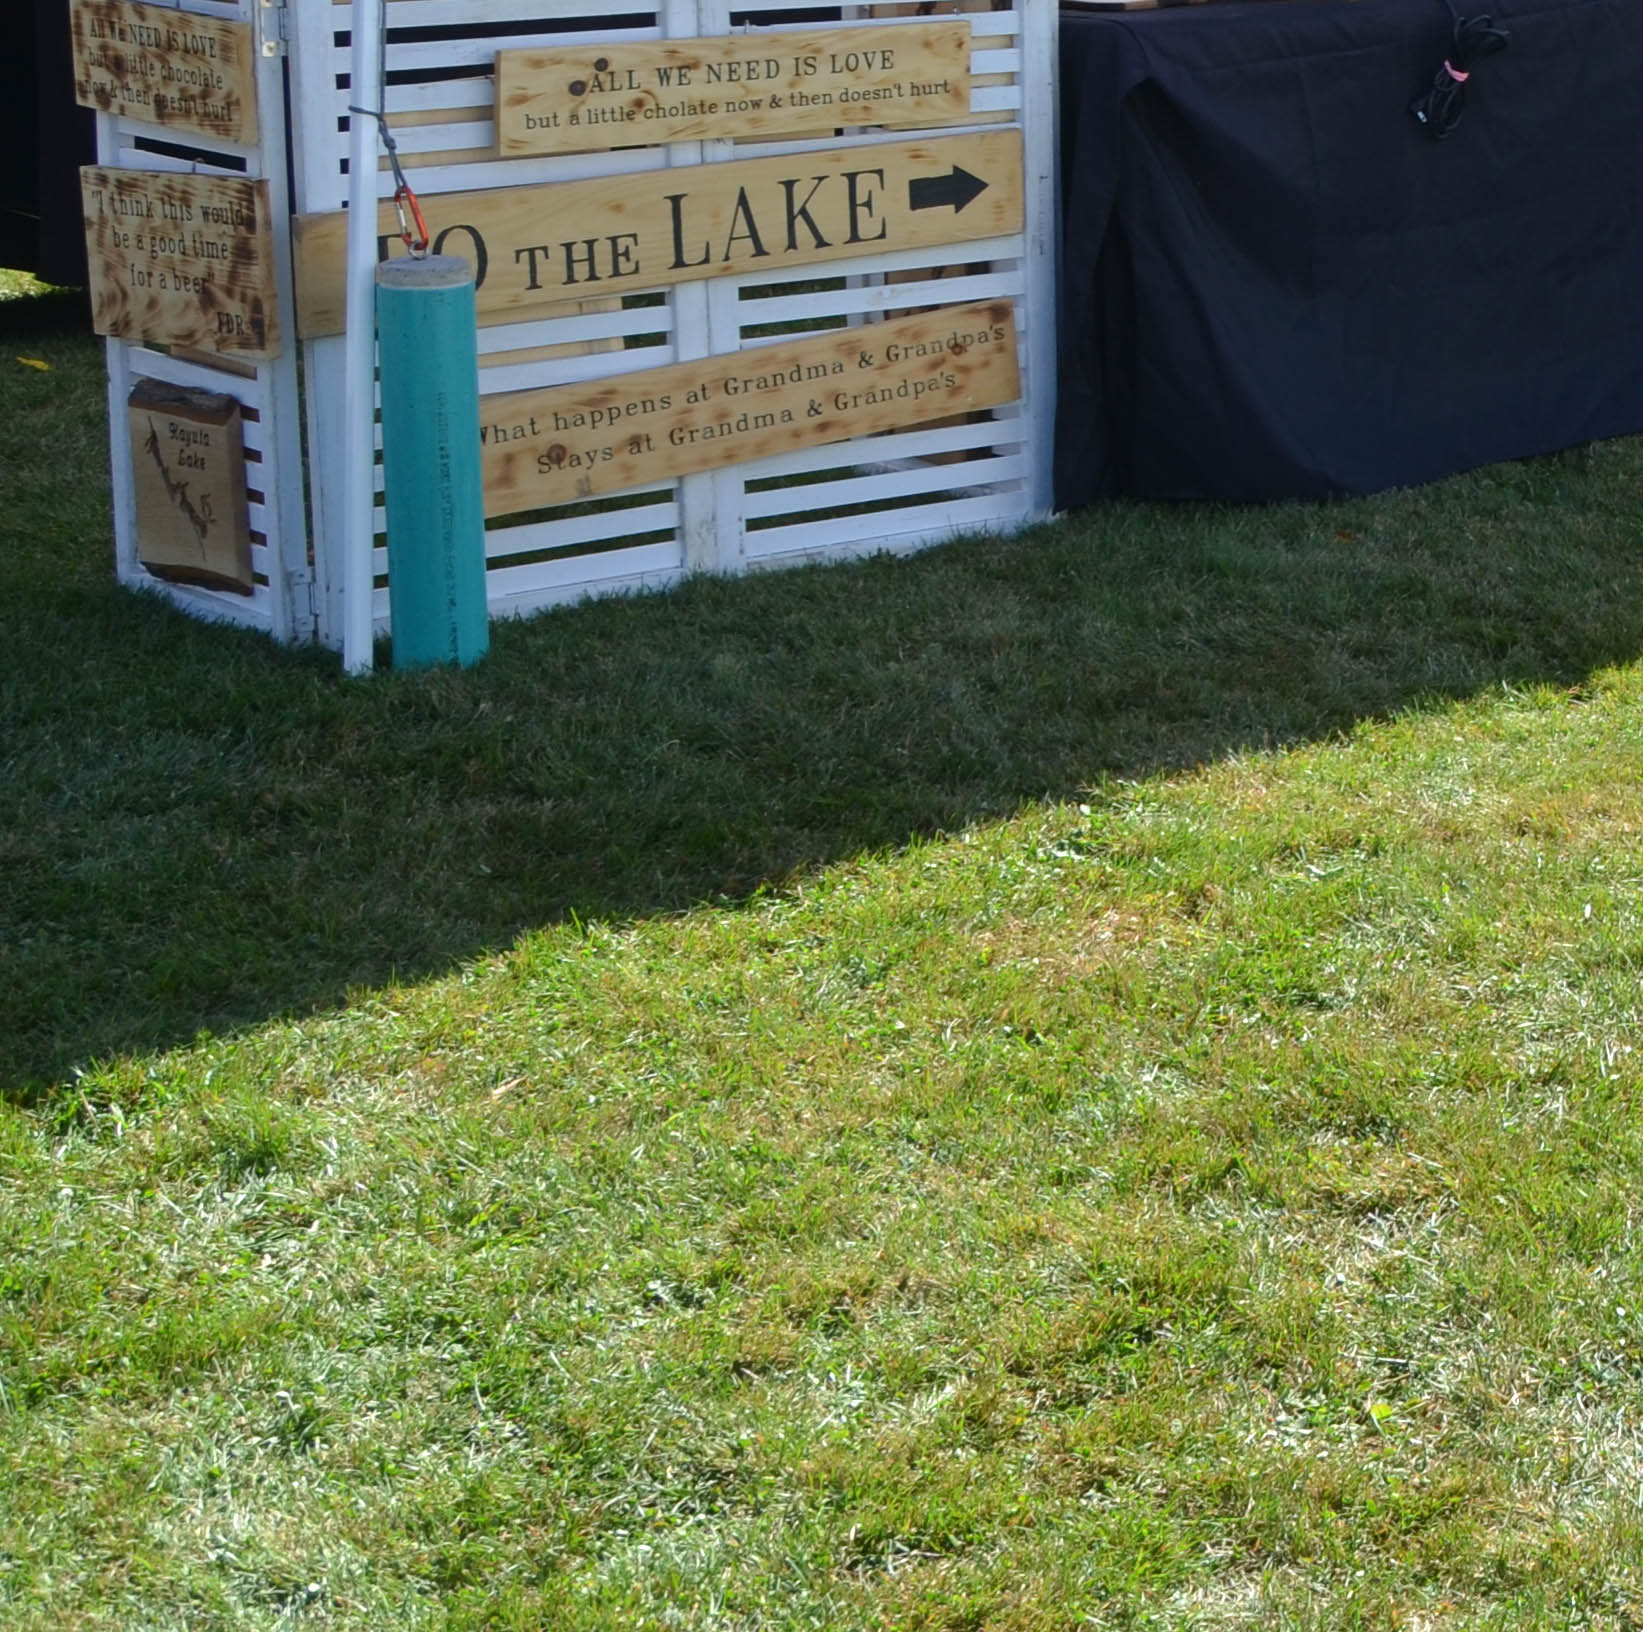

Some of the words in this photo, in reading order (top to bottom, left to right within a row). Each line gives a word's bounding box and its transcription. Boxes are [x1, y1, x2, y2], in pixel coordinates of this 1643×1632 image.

[129, 23, 162, 48] NEED
[166, 29, 179, 52] IS
[183, 32, 217, 58] LOVE
[160, 64, 223, 90] chocolate
[588, 68, 642, 95] ALL
[657, 65, 693, 88] WE
[705, 58, 782, 83] NEED
[793, 56, 818, 78] IS
[829, 49, 896, 76] LOVE
[525, 111, 561, 131] but
[568, 109, 582, 126] a
[586, 104, 637, 125] little
[642, 97, 719, 121] cholate
[725, 97, 763, 113] now
[769, 93, 784, 110] &
[789, 88, 834, 108] then
[839, 82, 905, 104] doesn't
[909, 79, 952, 98] hurt
[110, 193, 154, 218] think
[161, 196, 193, 221] this
[200, 200, 245, 225] would
[514, 233, 640, 290] THE
[663, 168, 888, 272] LAKE
[112, 225, 130, 249] be
[136, 237, 145, 250] a
[151, 232, 186, 260] good
[192, 232, 229, 260] time
[130, 263, 152, 288] for
[159, 275, 168, 290] a
[552, 393, 672, 433] happens
[685, 383, 711, 403] at
[723, 359, 845, 397] Grandma
[857, 350, 875, 369] &
[884, 324, 1006, 363] Grandpa's
[537, 442, 614, 475] Stays
[629, 434, 656, 456] at
[668, 406, 794, 447] Grandma
[806, 399, 824, 418] &
[834, 372, 957, 412] Grandpa's
